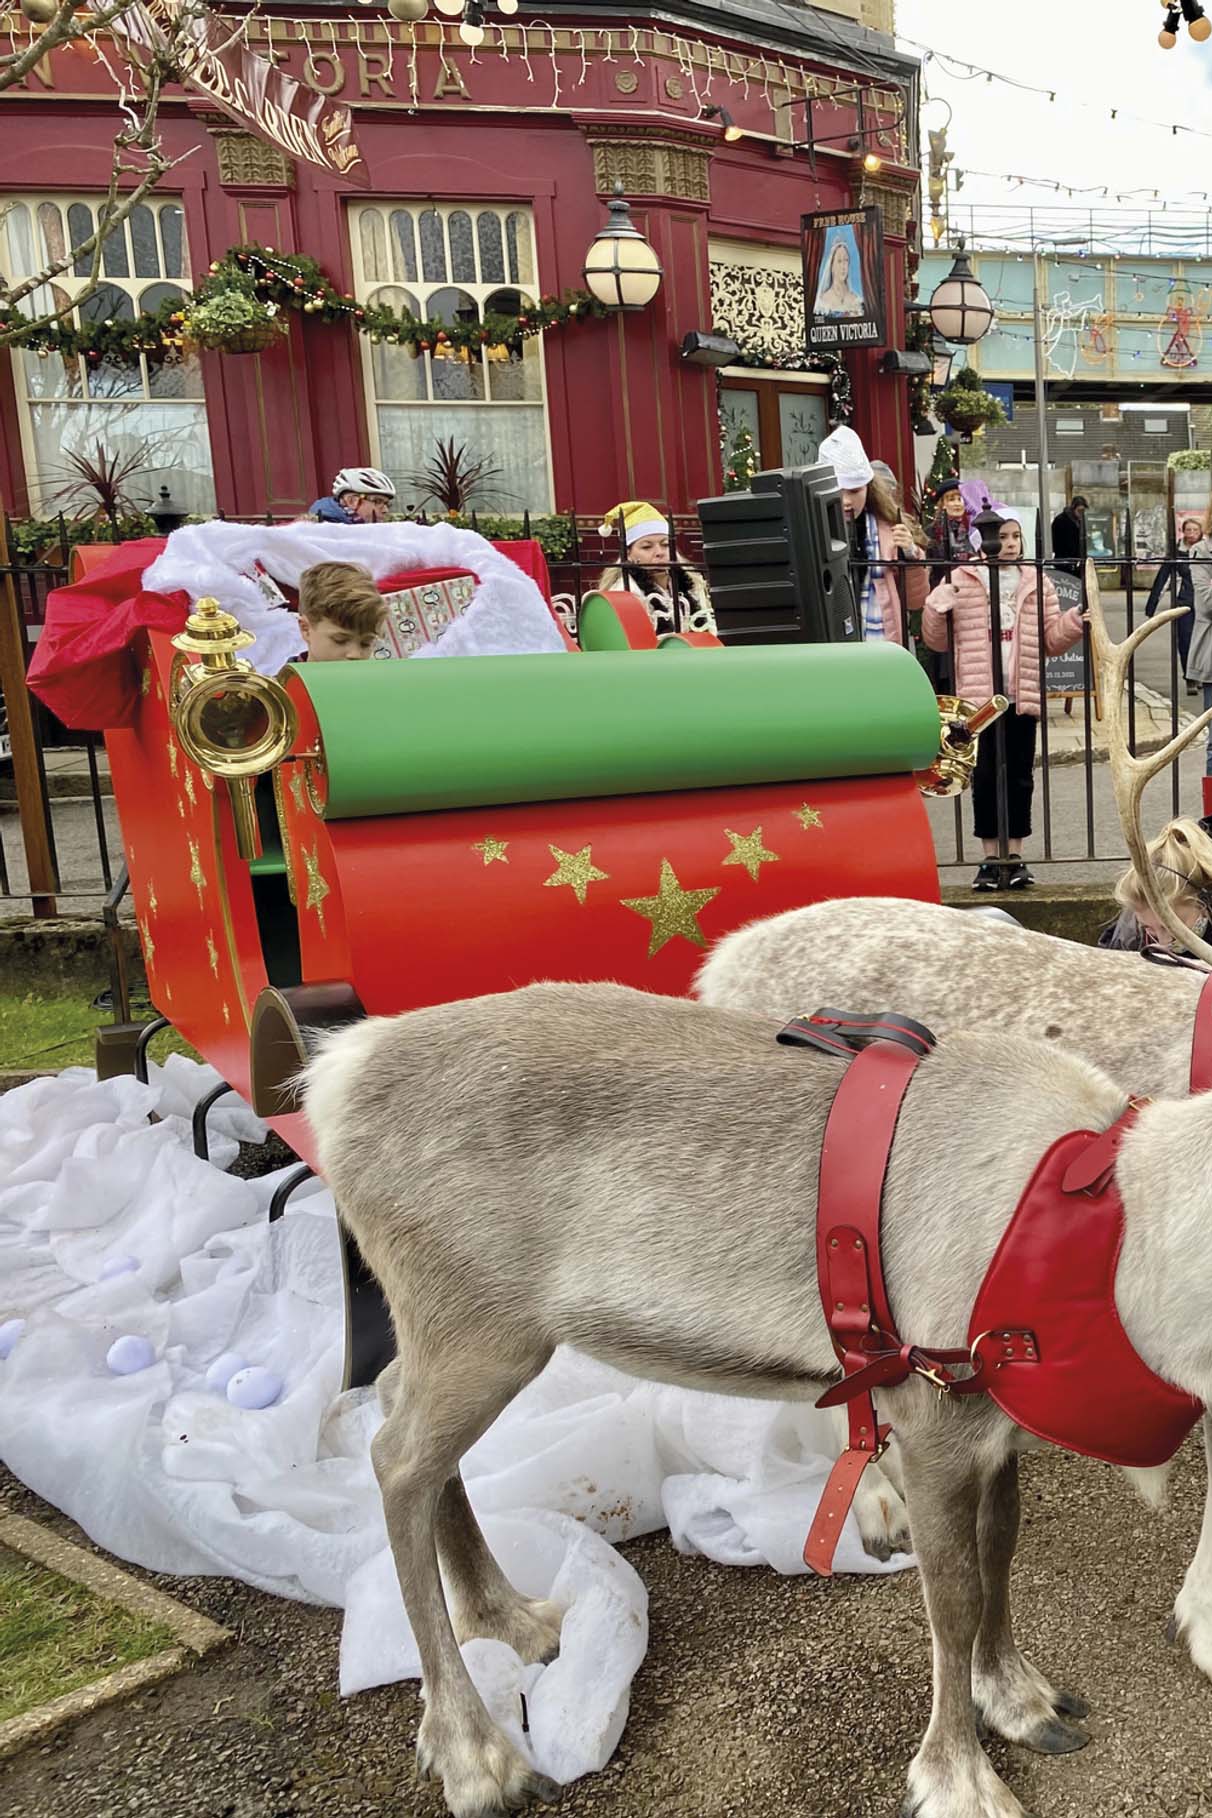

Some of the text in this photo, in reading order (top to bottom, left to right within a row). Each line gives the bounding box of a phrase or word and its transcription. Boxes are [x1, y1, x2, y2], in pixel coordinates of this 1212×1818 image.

[838, 212, 866, 225] HOUSE
[810, 321, 879, 343] QUEEN VICTORIA
